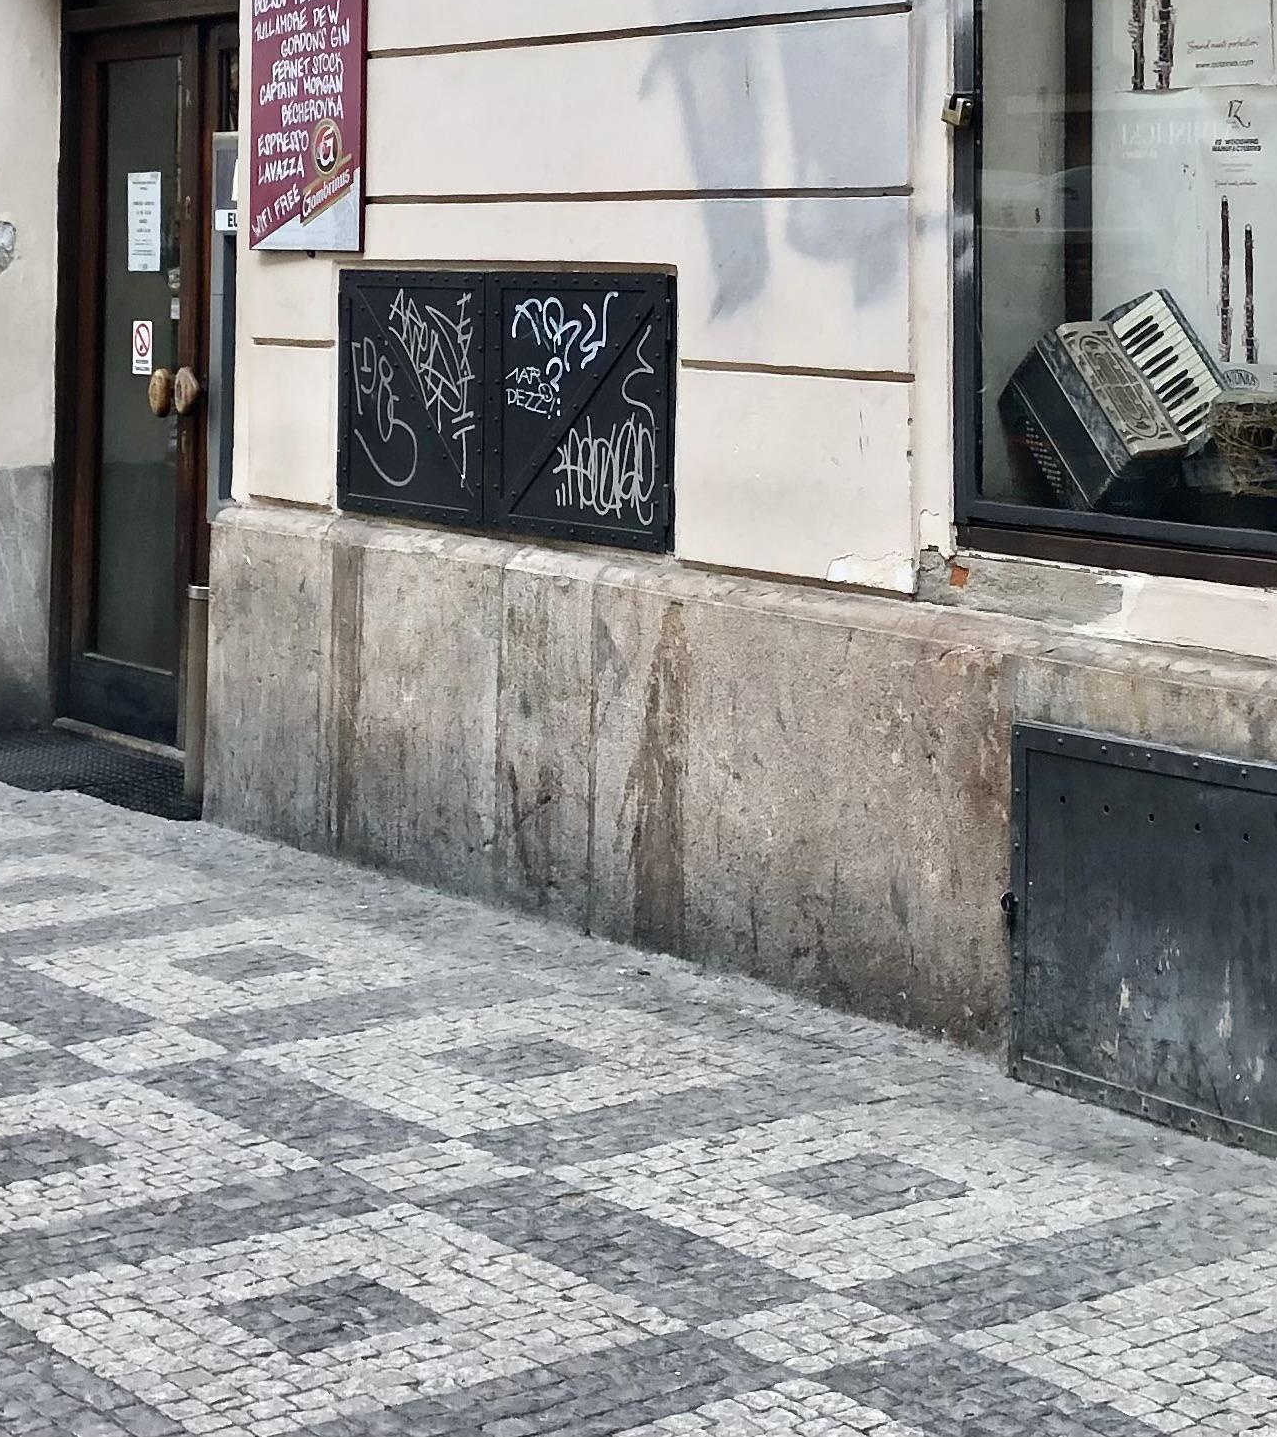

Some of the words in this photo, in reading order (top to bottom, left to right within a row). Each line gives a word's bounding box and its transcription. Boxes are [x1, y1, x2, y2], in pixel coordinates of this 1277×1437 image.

[254, 7, 308, 43] TULLAMORE
[313, 0, 341, 29] DEW
[331, 18, 351, 48] GIN
[272, 57, 311, 82] FERNET
[311, 52, 344, 76] STOCK
[259, 80, 299, 106] CAPTAIN
[303, 72, 344, 98] MORGAN
[257, 129, 310, 157] ESPRESSO
[257, 154, 305, 186] LAVAZZA
[302, 168, 351, 218] Gambrinus
[251, 205, 273, 238] WIFI
[273, 183, 301, 220] FREE
